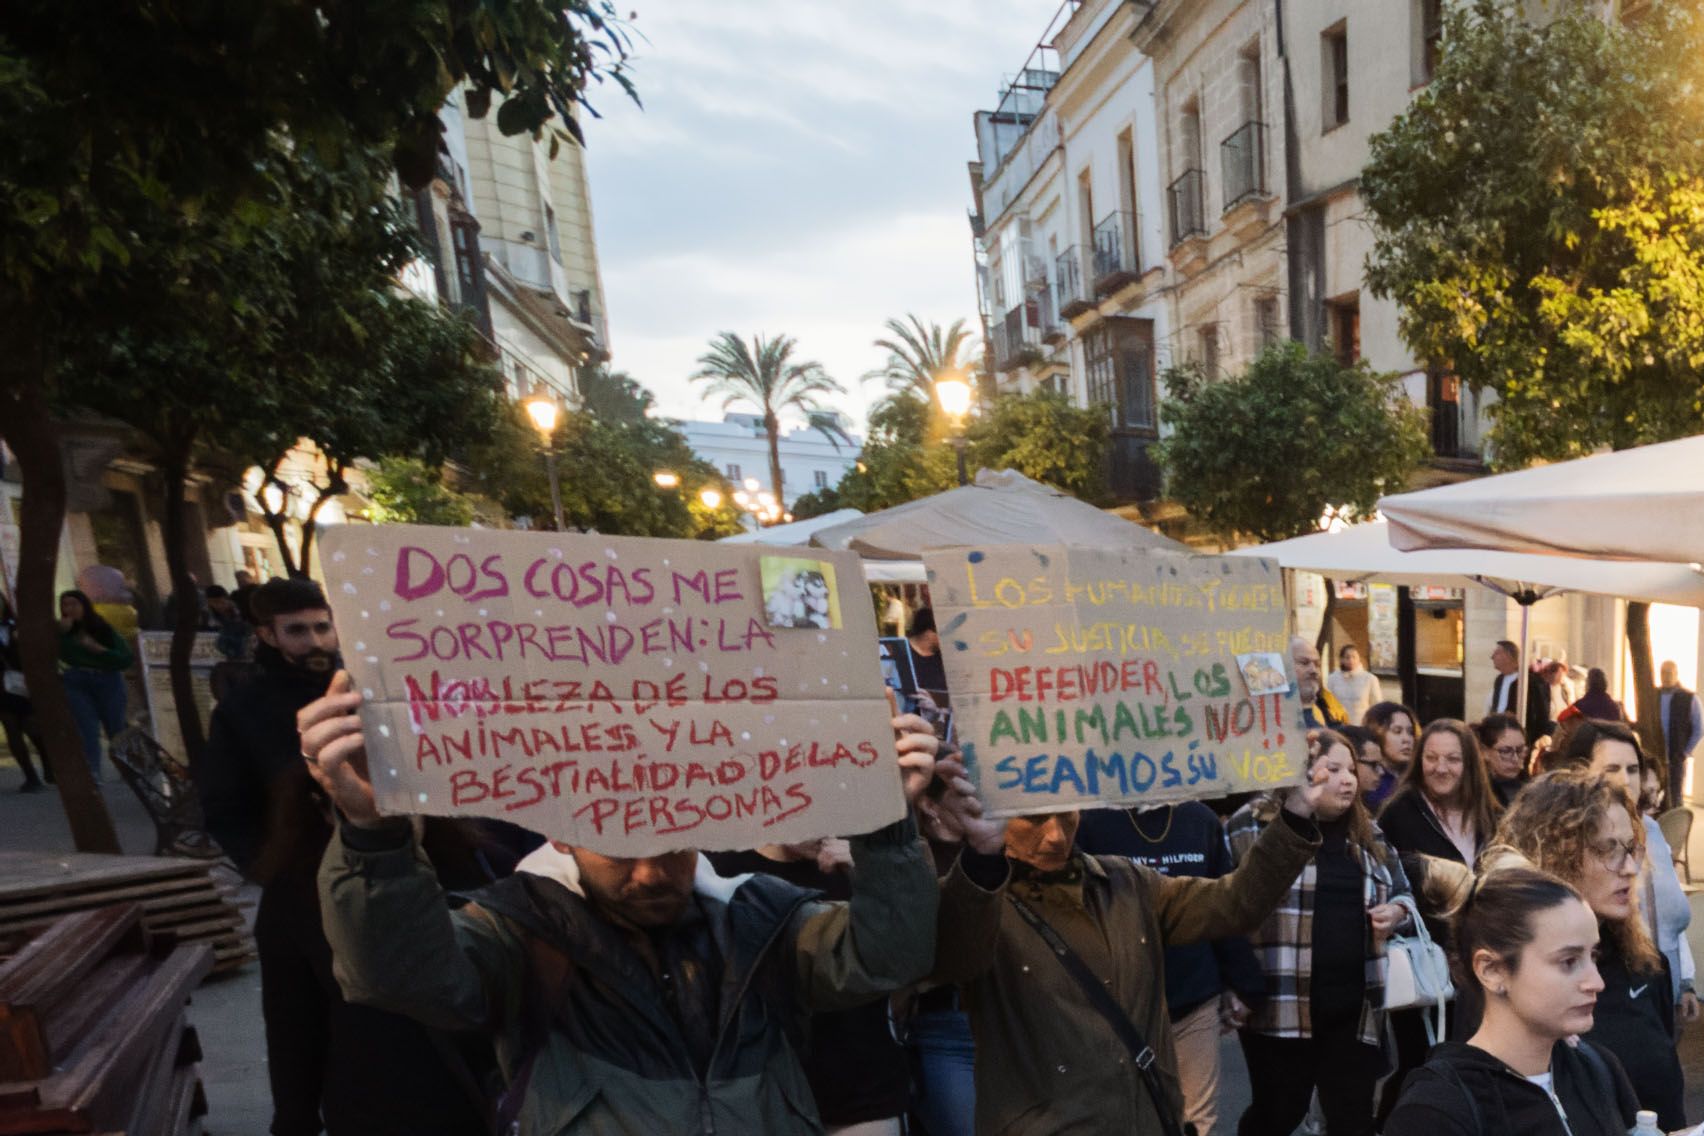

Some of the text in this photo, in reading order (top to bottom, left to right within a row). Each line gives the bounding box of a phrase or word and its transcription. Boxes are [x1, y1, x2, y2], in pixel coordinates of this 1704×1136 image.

[394, 546, 744, 607] DOS COSAS ME
[967, 563, 1052, 609] LOS
[717, 619, 775, 653] LA
[405, 670, 778, 727] NOBLEZA DE LOS
[1168, 662, 1231, 700] LOS
[649, 718, 680, 752] Y
[690, 719, 734, 747] LA
[989, 700, 1194, 747] ANIMALES
[450, 755, 747, 811] BESTIALIDAD
[994, 748, 1183, 796] SEAMOS
[1228, 749, 1295, 784] VOZ
[575, 782, 812, 836] PERSONAS
